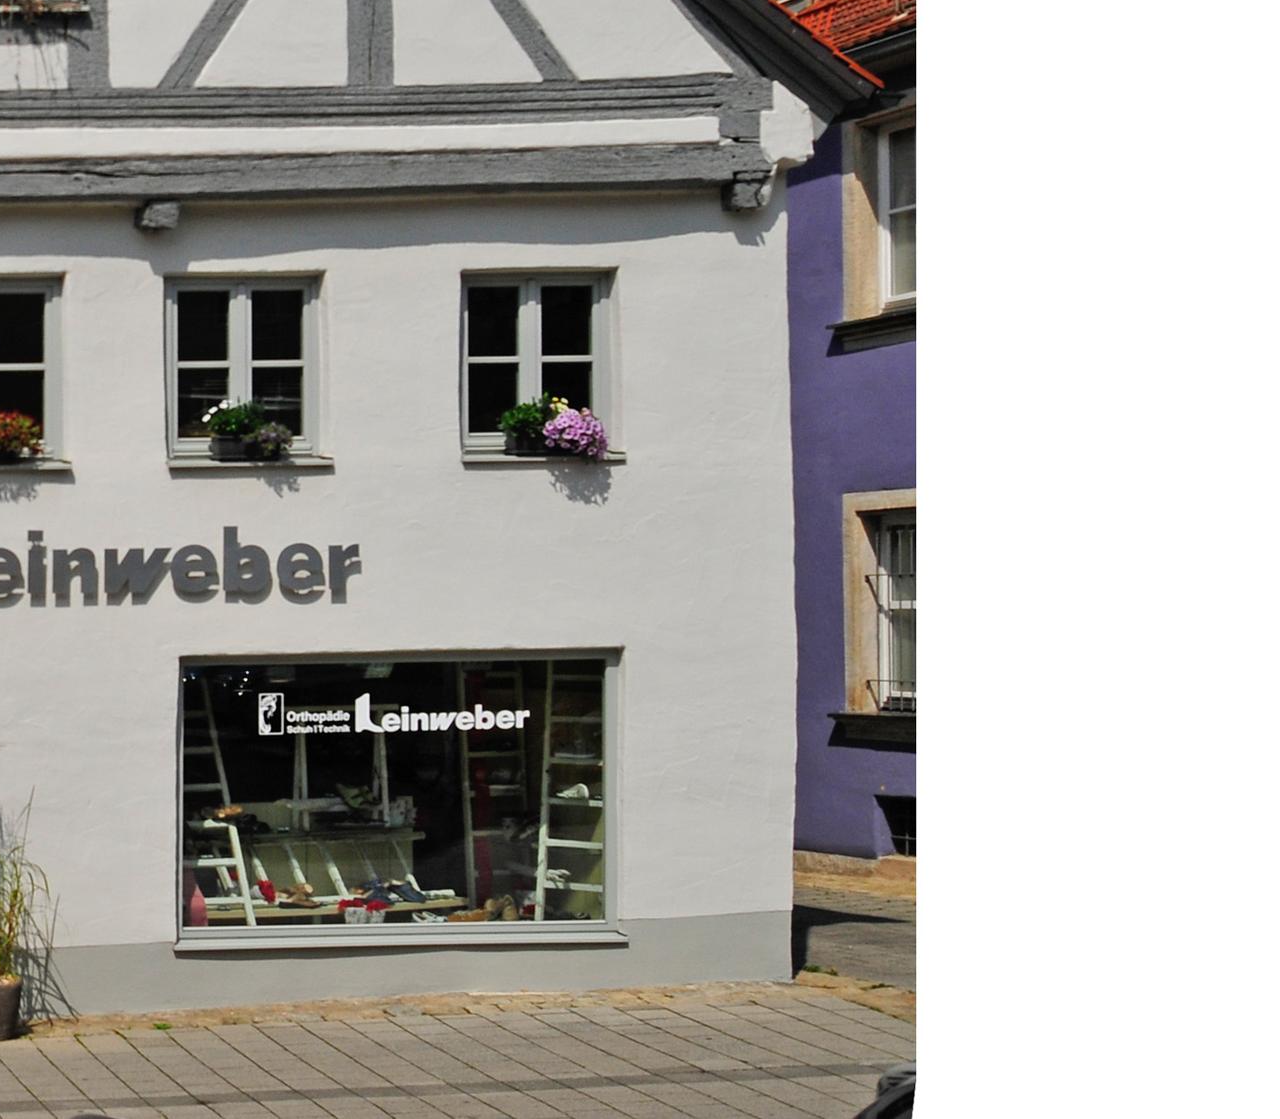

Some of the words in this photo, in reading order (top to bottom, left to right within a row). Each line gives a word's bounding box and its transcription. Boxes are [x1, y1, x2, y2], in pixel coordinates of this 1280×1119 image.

[286, 710, 351, 724] Orthopädie
[354, 692, 531, 734] Leinweber
[318, 724, 351, 734] Technik
